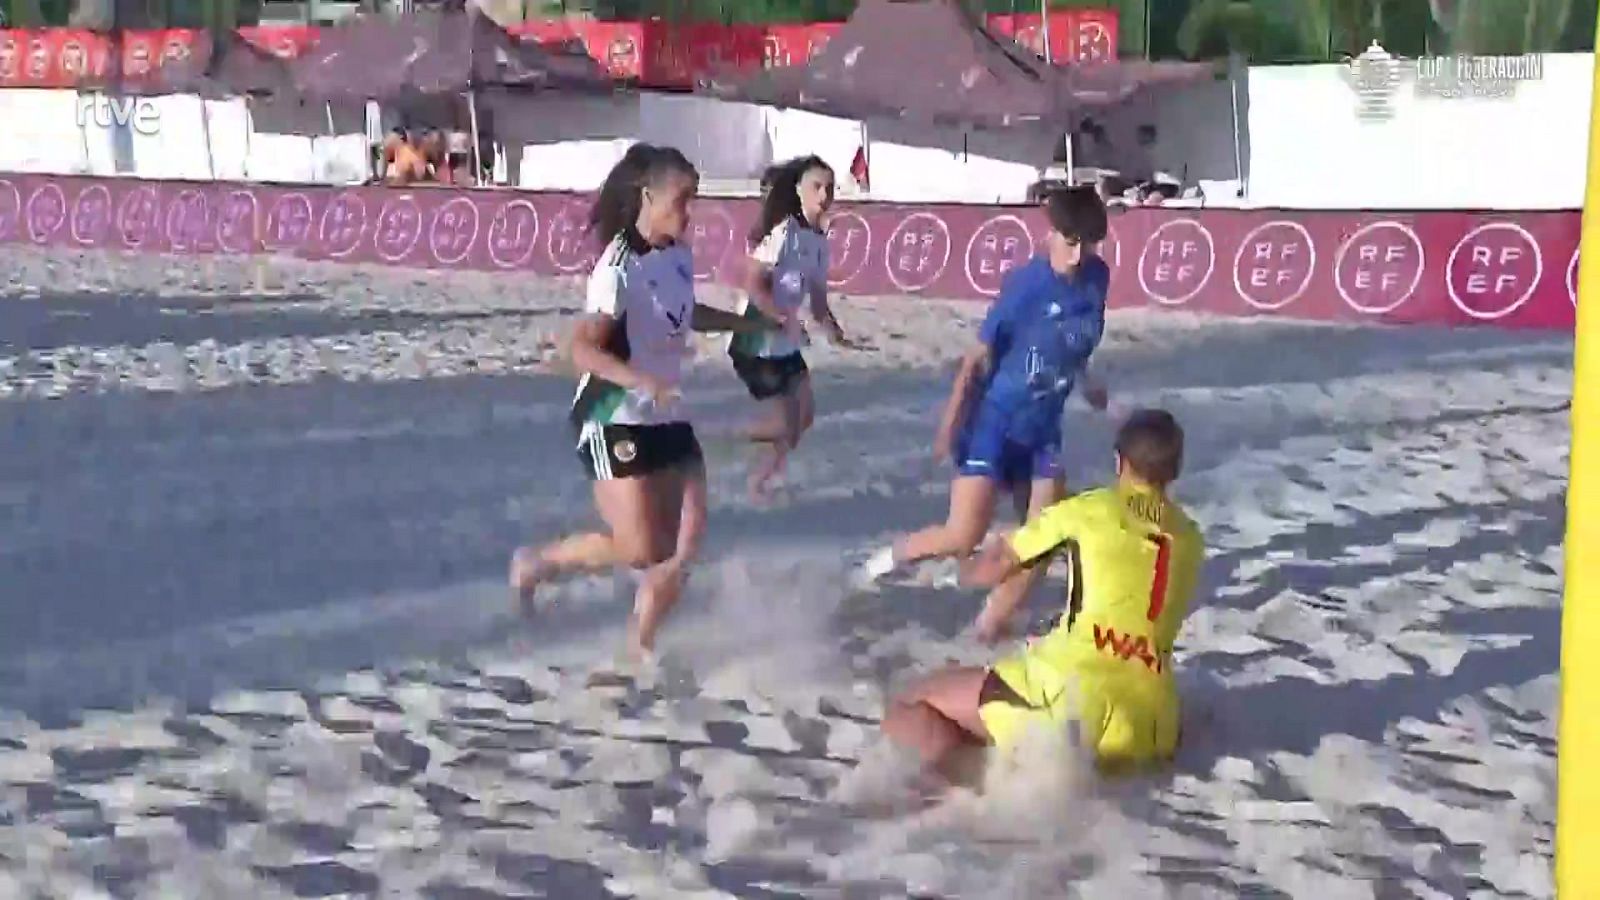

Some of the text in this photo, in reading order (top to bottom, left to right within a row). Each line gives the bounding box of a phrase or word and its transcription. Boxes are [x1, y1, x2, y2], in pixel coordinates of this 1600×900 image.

[1159, 240, 1198, 257] RF
[1255, 242, 1301, 261] RF
[1359, 245, 1406, 264] RF
[1472, 246, 1523, 267] RF
[1154, 264, 1195, 282] EF
[1251, 268, 1296, 288] EF
[1354, 270, 1399, 290] EF
[1466, 274, 1517, 295] EF
